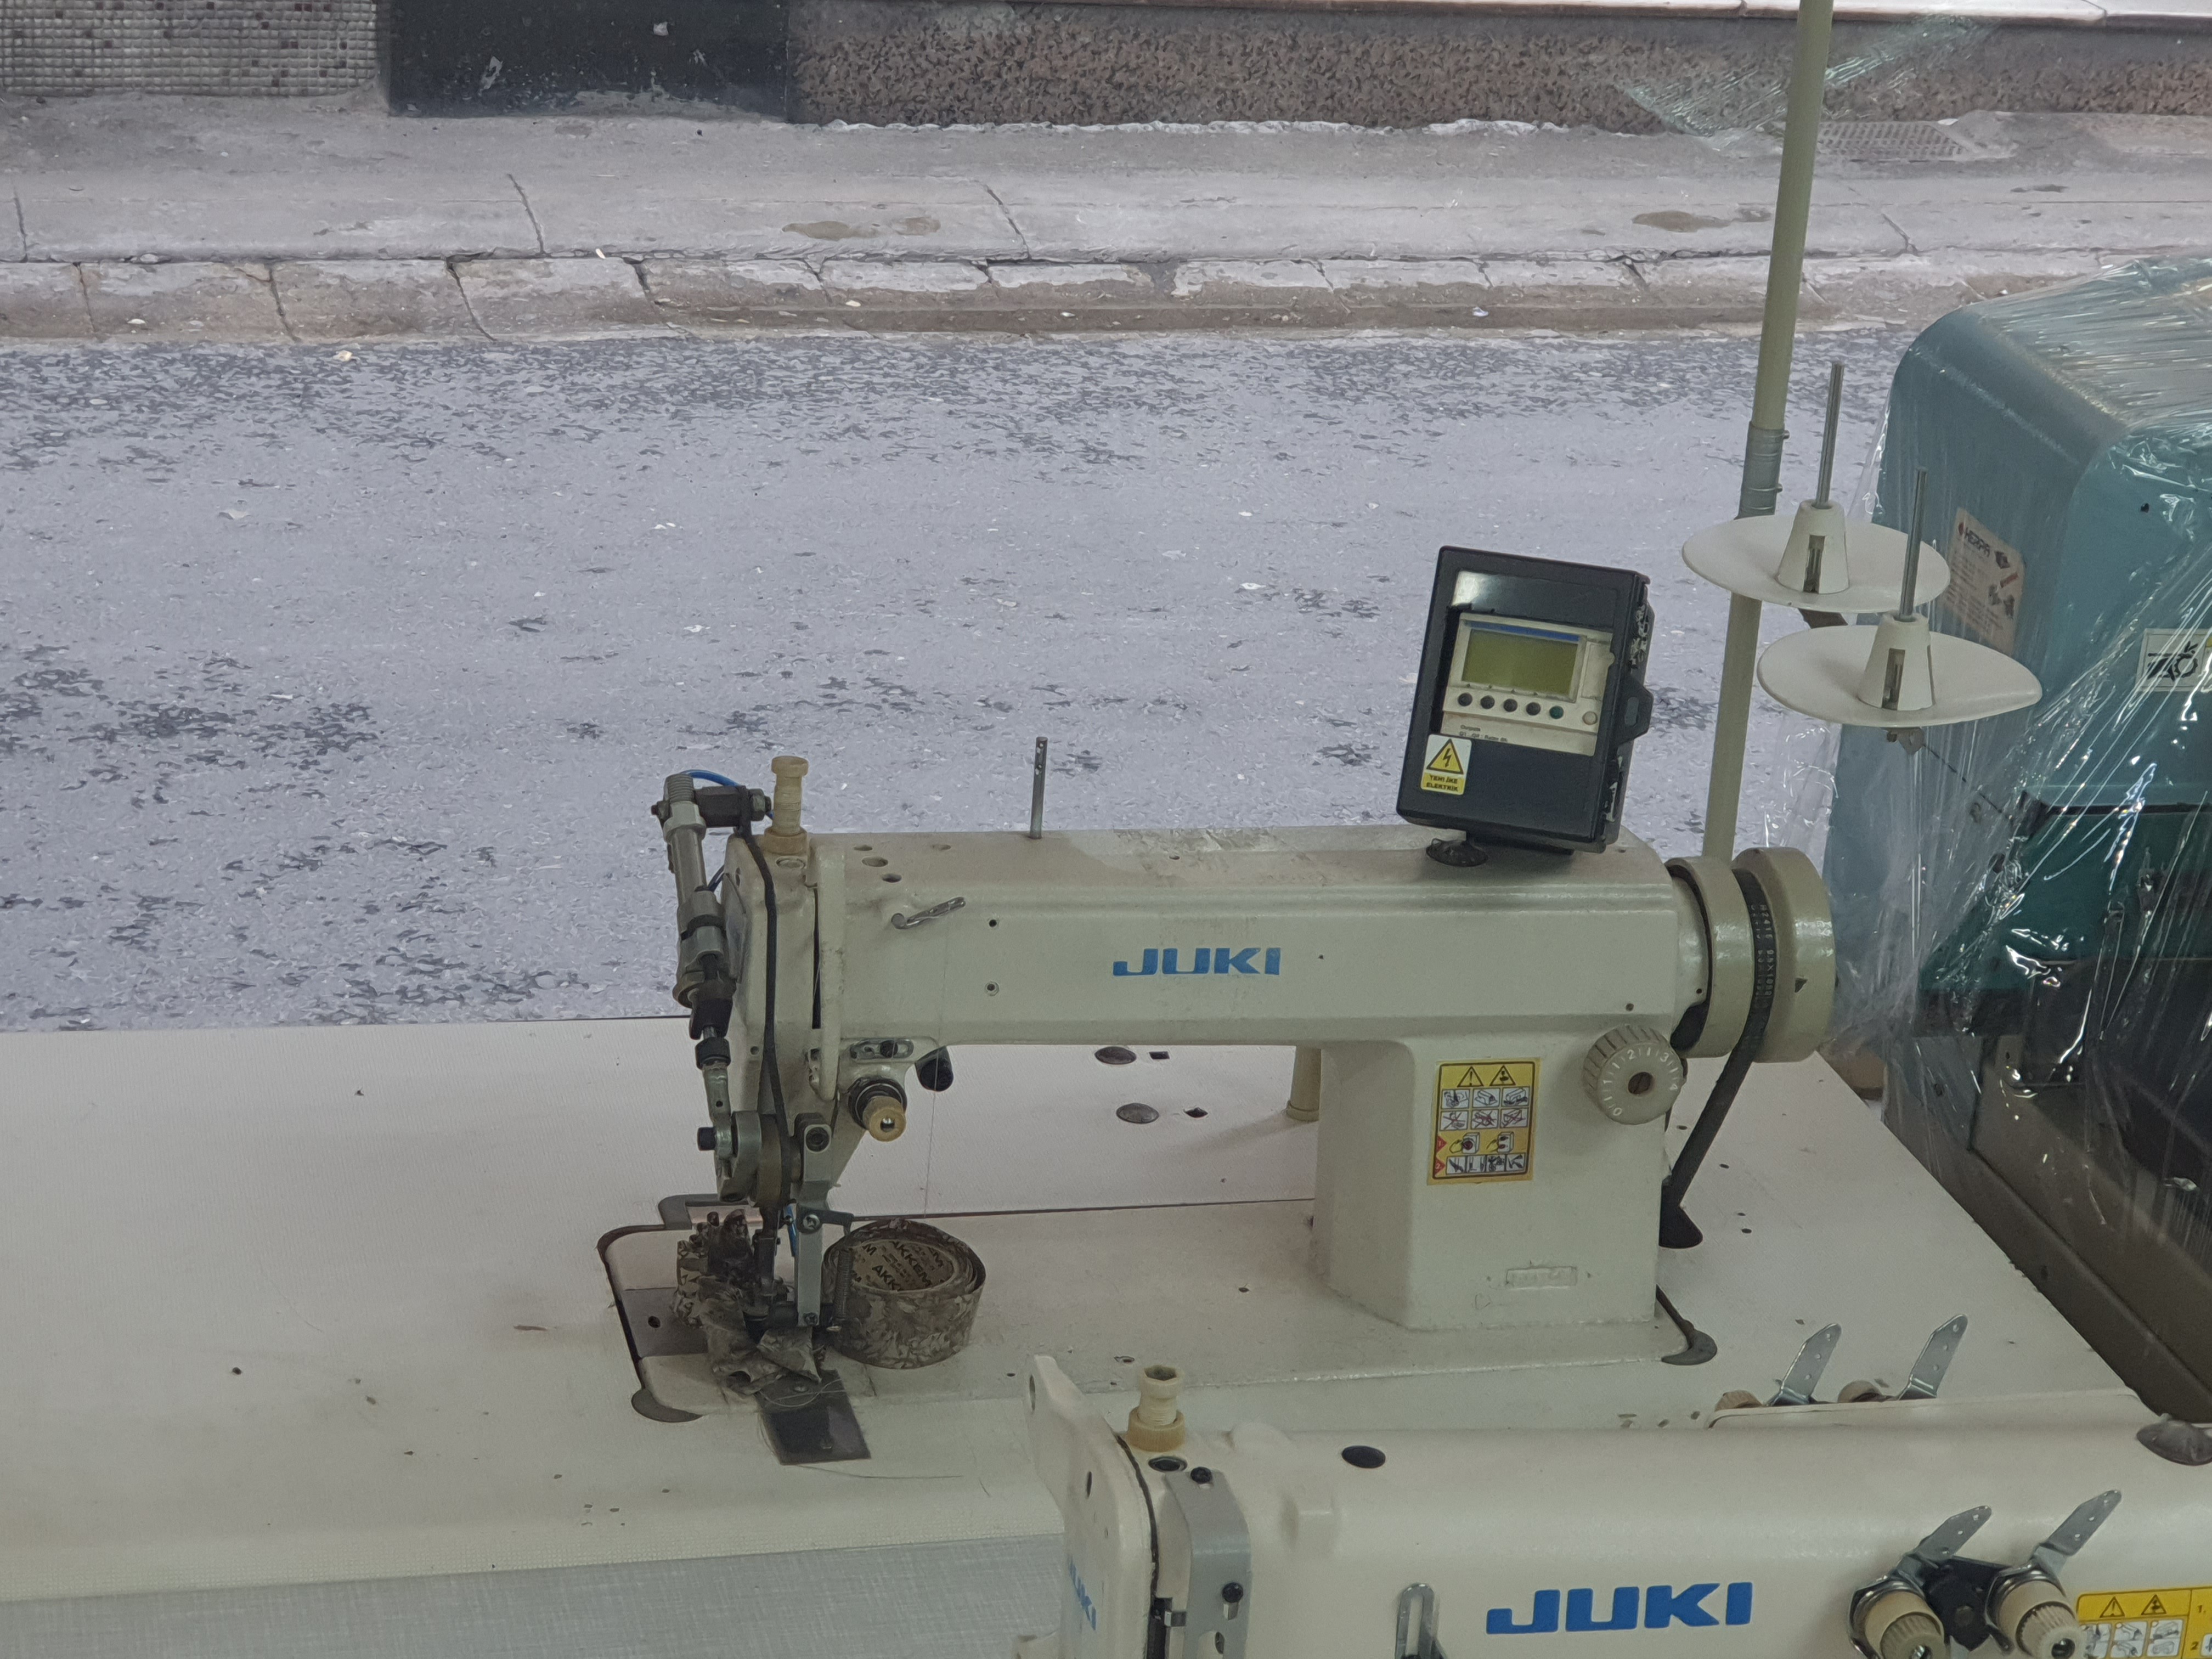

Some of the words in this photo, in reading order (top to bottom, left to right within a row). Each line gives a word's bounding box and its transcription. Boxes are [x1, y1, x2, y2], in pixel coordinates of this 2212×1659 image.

[1113, 947, 1281, 977] JUKI
[1627, 1049, 1635, 1059] 2
[1660, 1052, 1669, 1062] 3
[1486, 1582, 1753, 1635] JUKI
